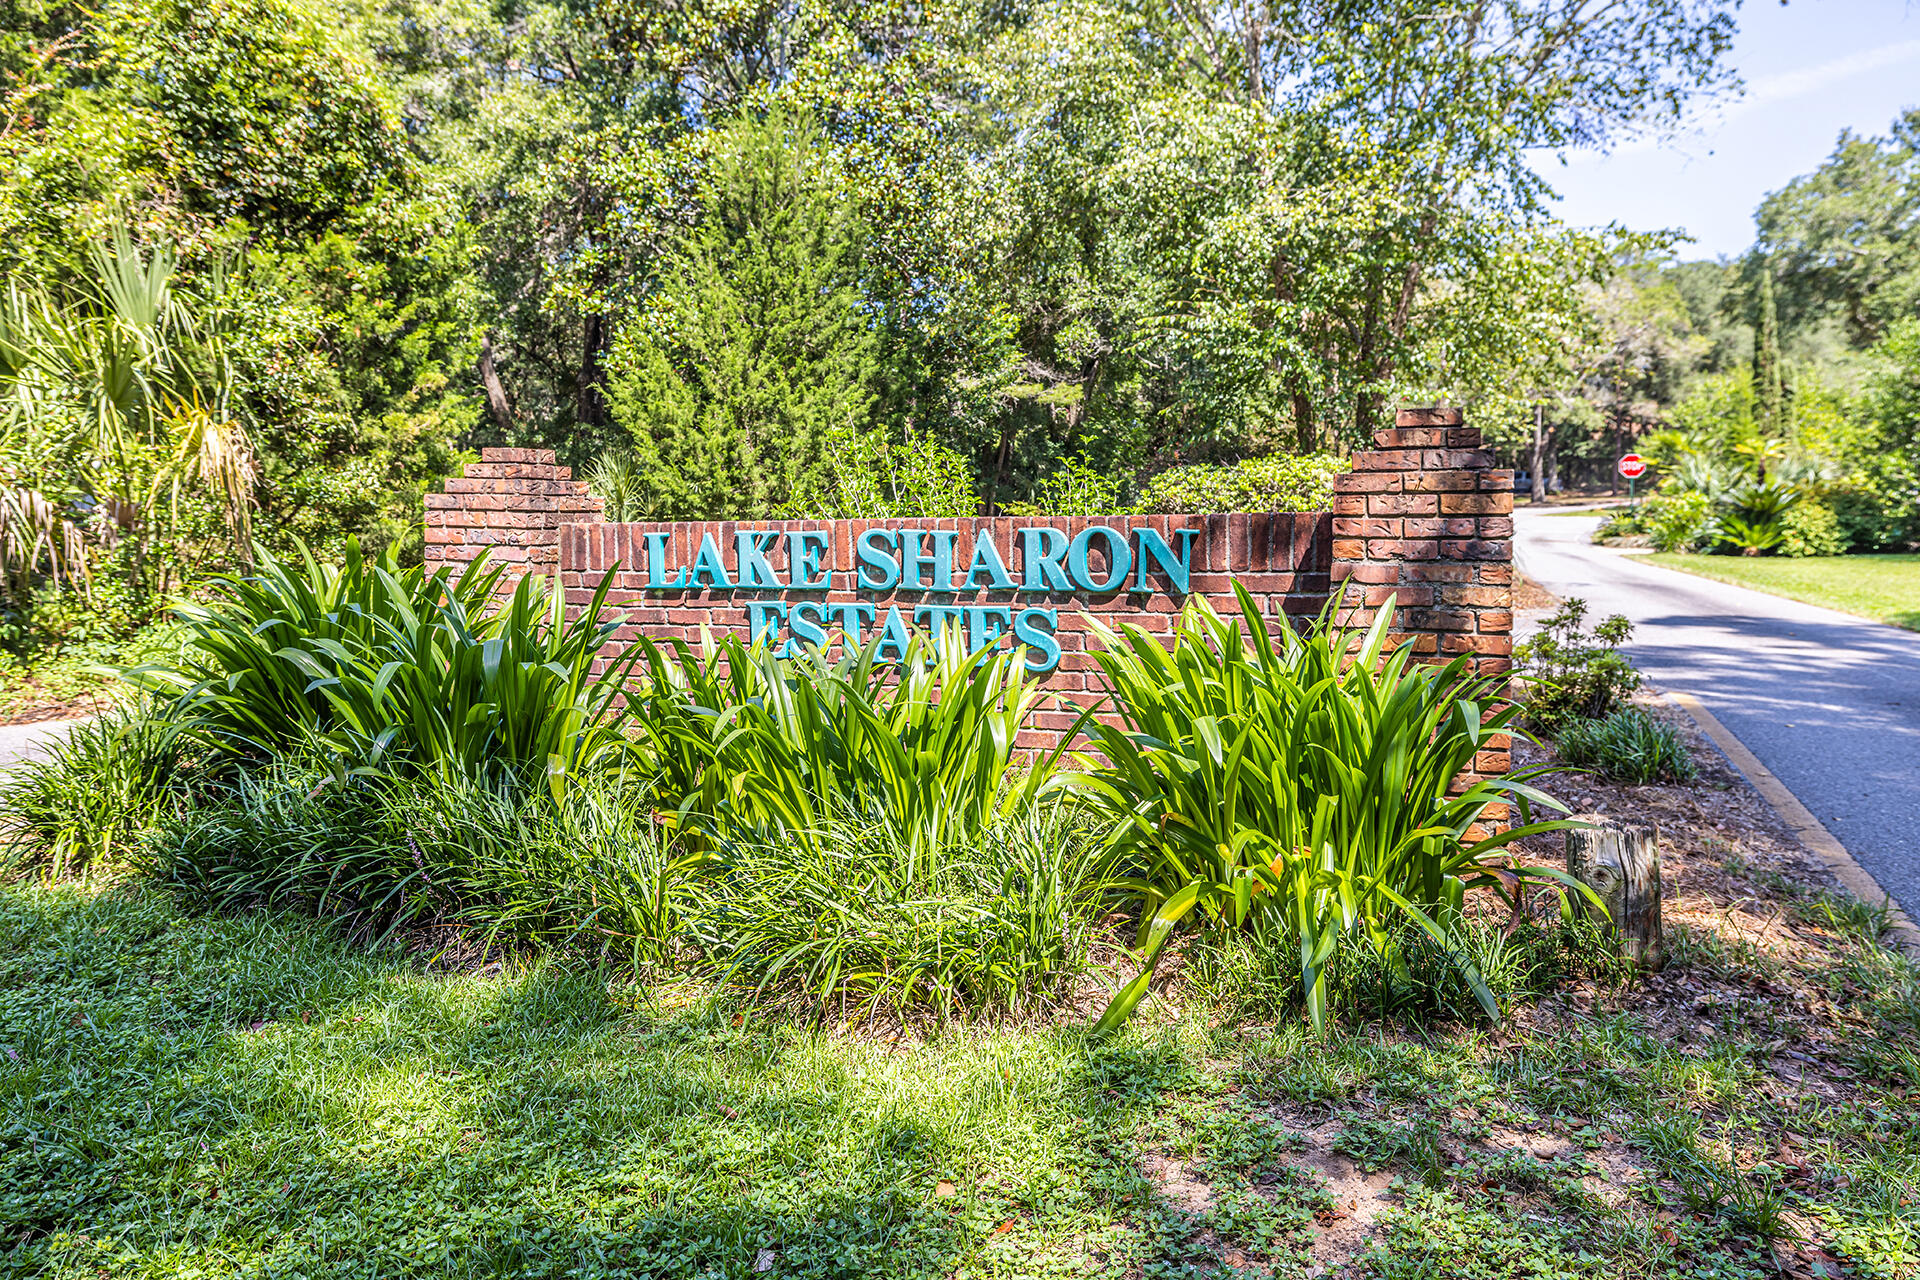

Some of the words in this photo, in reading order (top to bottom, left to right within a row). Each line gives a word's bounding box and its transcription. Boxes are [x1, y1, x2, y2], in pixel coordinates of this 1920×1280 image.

[643, 531, 832, 591] LAKE
[857, 527, 1200, 594] SHARON
[746, 600, 1061, 673] ESTATES
